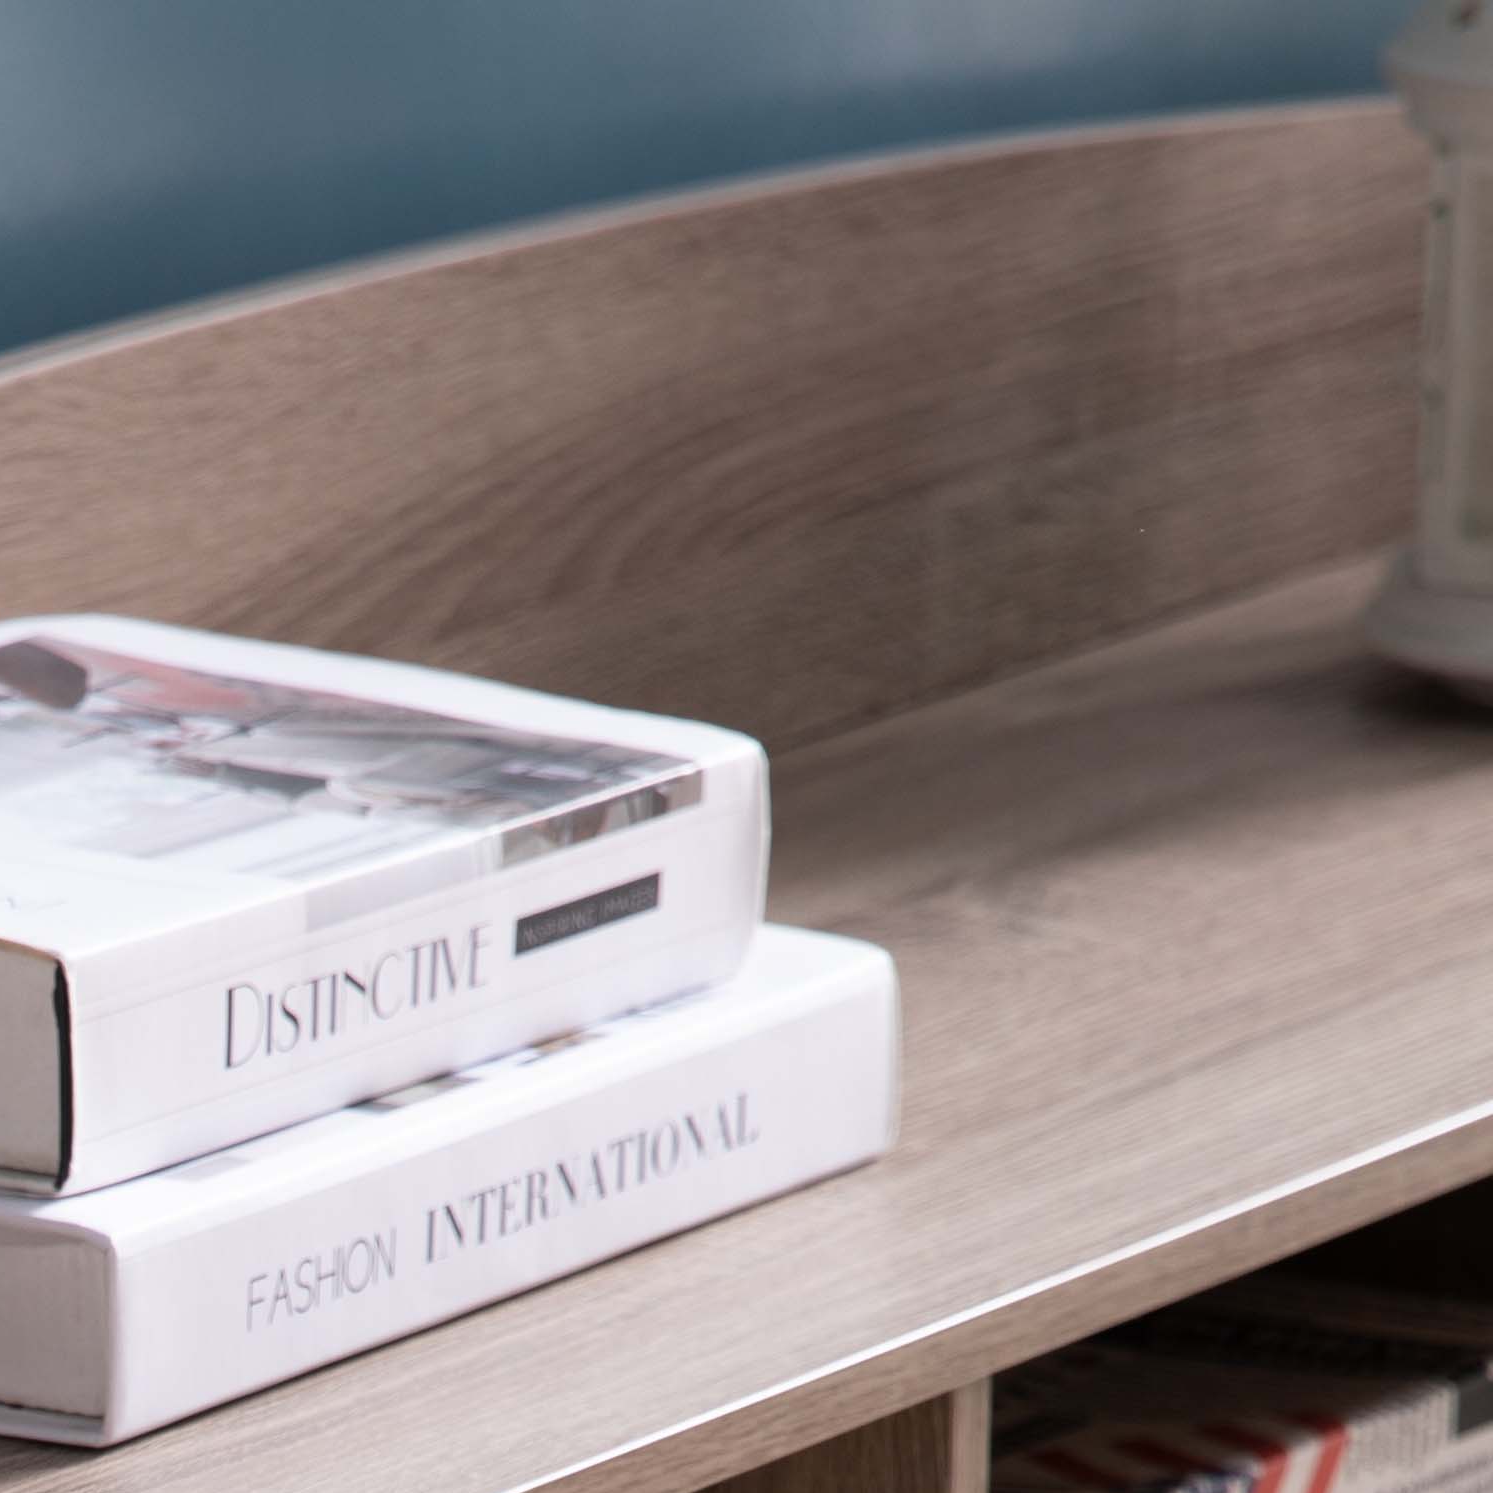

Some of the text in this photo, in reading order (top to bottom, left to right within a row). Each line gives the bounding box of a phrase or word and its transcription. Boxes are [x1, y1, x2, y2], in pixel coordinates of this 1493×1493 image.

[224, 922, 493, 1069] DISTINCTIVE
[246, 1093, 760, 1331] FASHION INTERNATIONAL
